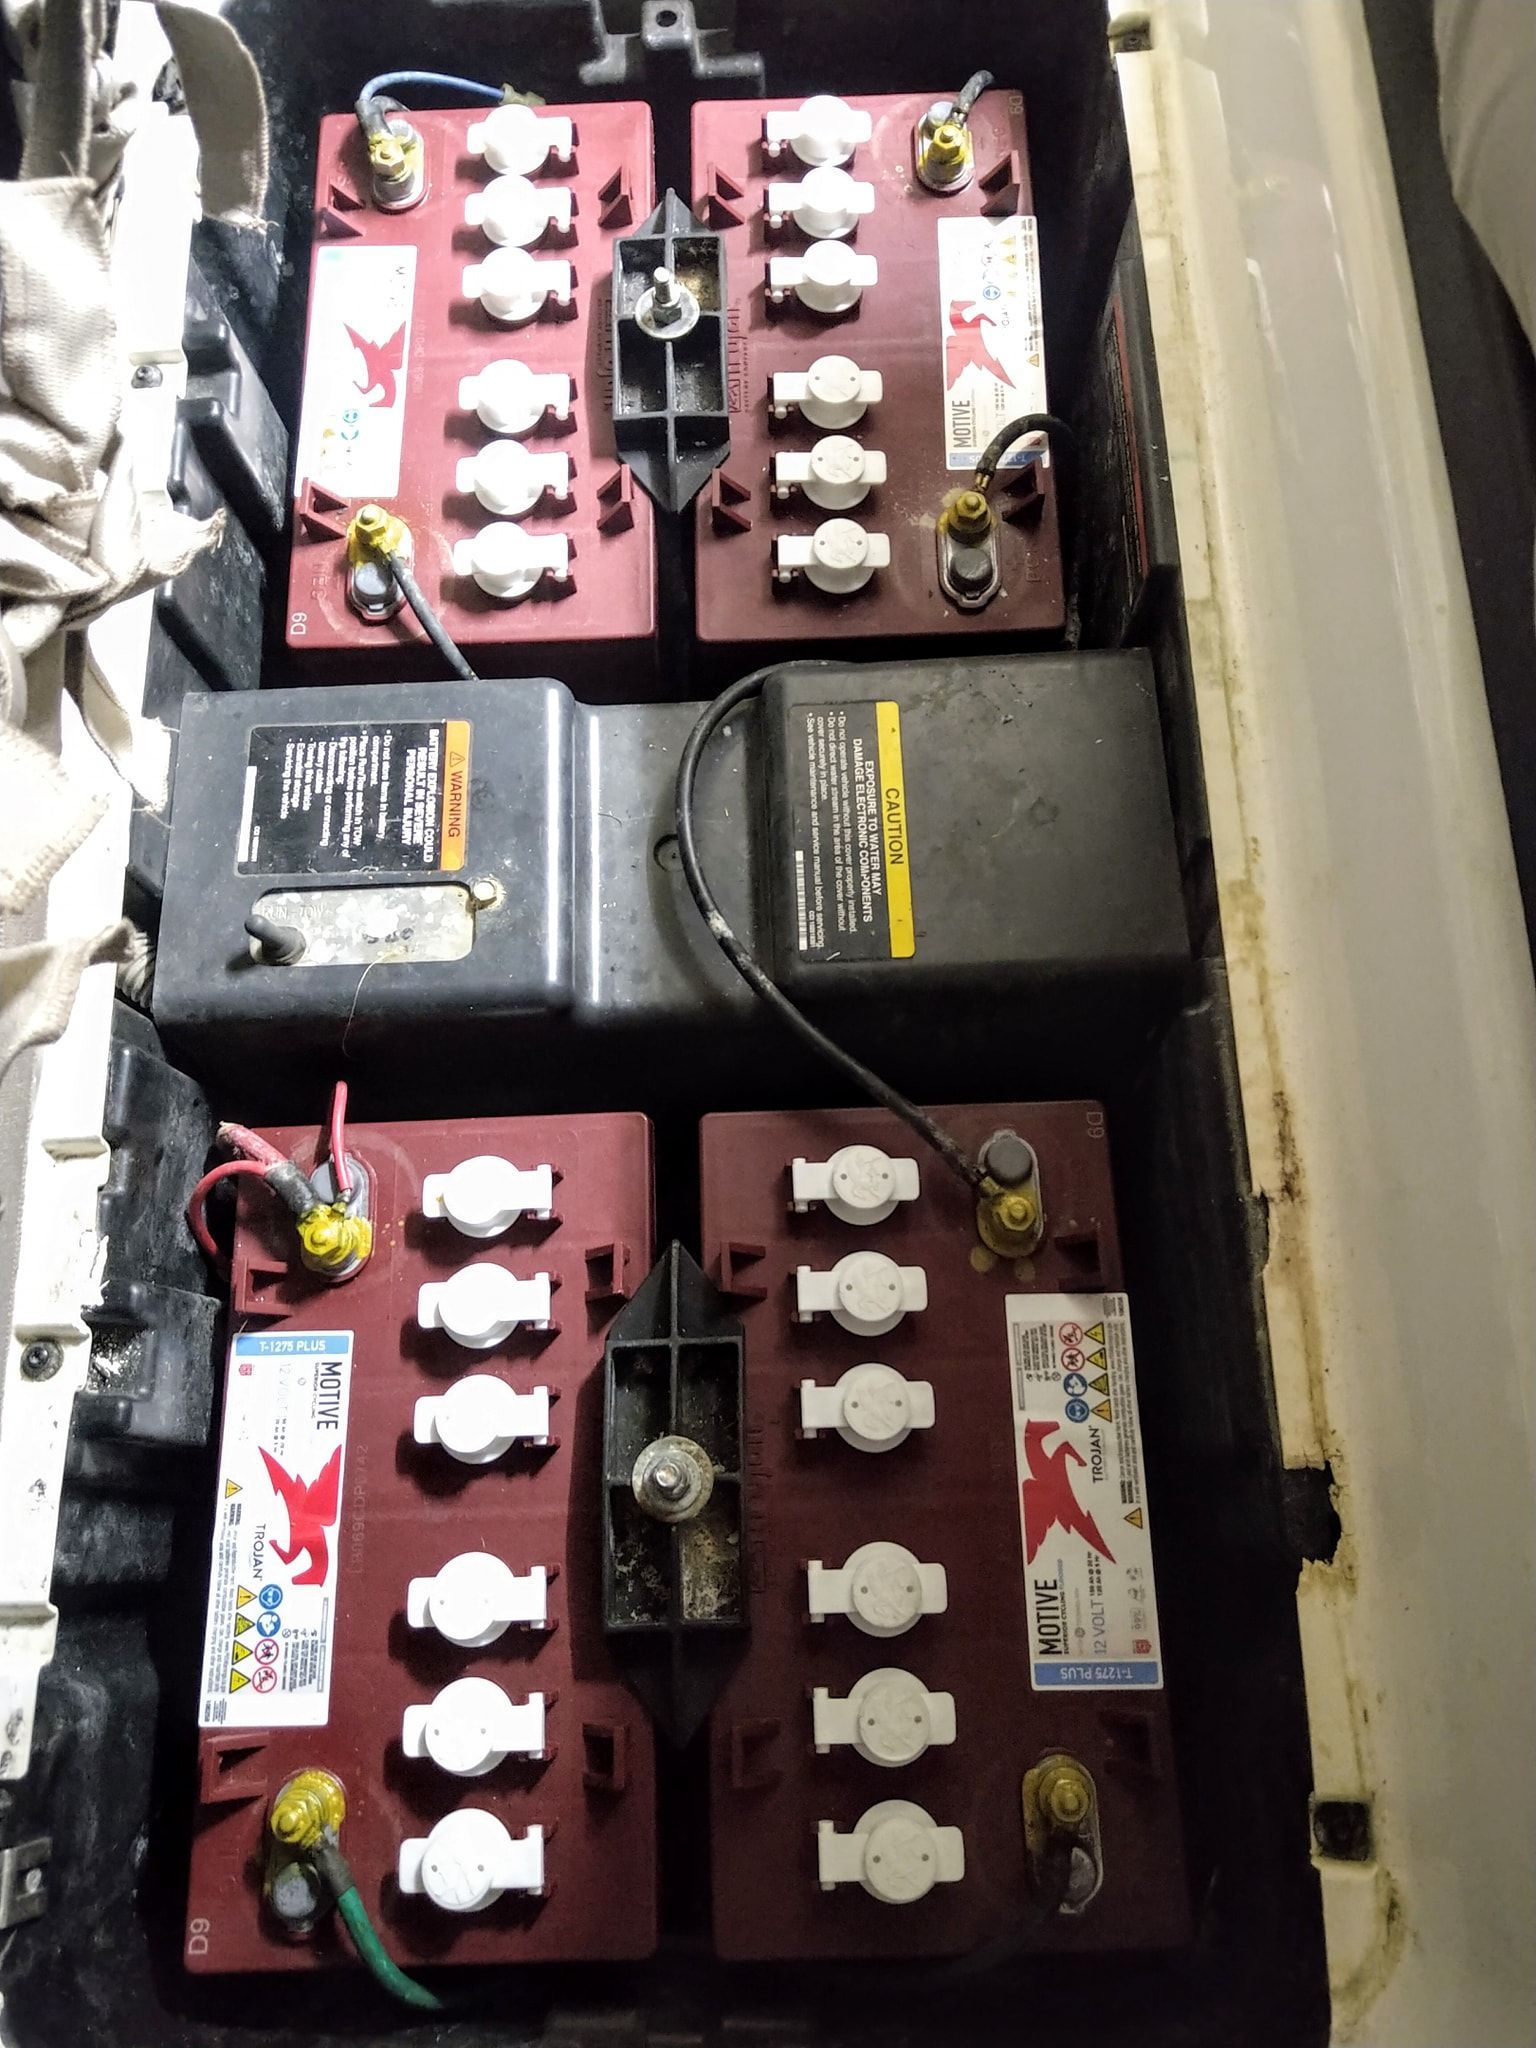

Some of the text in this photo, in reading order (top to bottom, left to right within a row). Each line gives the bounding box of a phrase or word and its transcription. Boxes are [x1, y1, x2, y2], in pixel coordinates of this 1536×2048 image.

[951, 400, 971, 447] MOTIVE
[290, 611, 308, 635] D9
[806, 717, 814, 733] See
[827, 716, 835, 727] Do
[828, 729, 836, 741] not
[837, 716, 846, 727] Do
[838, 728, 846, 740] not
[358, 735, 368, 757] Place
[382, 747, 391, 759] not
[383, 735, 392, 746] Do
[807, 733, 815, 760] vehicle
[816, 738, 826, 769] securely
[829, 742, 837, 762] direct
[314, 741, 326, 793] battery cables
[838, 741, 847, 770] operate
[280, 742, 294, 819] Servicing the vehicle
[290, 742, 305, 807] Extended storage
[302, 742, 315, 810] Towing this vehicle
[381, 761, 390, 780] store
[319, 741, 336, 846] Disconnecting or connecting
[340, 736, 357, 857] position before performing any of
[379, 781, 388, 802] items
[400, 748, 415, 845] PERSONAL INJURY
[412, 747, 427, 844] RESULT IN SEVERE
[422, 728, 439, 862] BATTERY EXPLOSION COULD
[808, 761, 818, 809] maintenance
[840, 771, 849, 798] vehicle
[354, 792, 364, 815] switch
[447, 770, 463, 837] WARNING
[831, 787, 839, 813] stream
[842, 799, 850, 826] without
[375, 812, 387, 838] battery
[811, 811, 819, 825] and
[852, 738, 872, 922] DAMAGE ELECTRONIC COMPONENTS
[864, 760, 881, 895] EXPOSURE TO WATER MAY
[885, 788, 904, 864] CAUTION
[352, 825, 362, 845] TOW
[812, 827, 820, 853] service
[843, 828, 851, 841] this
[813, 855, 822, 884] manual
[835, 866, 843, 877] the
[844, 866, 854, 898] properly
[814, 886, 823, 910] before
[835, 880, 843, 901] cover
[836, 903, 845, 930] without
[259, 1340, 325, 1351] T-1275 PLUS
[316, 1362, 341, 1429] MOTIVE
[1088, 1428, 1103, 1482] TROJAN
[251, 1524, 266, 1578] TROJAN
[1034, 1579, 1062, 1654] MOTIVE
[1090, 1599, 1106, 1653] 12 VOLT
[1060, 1666, 1132, 1678] T-1275 PLUS
[187, 1918, 209, 1954] D9
